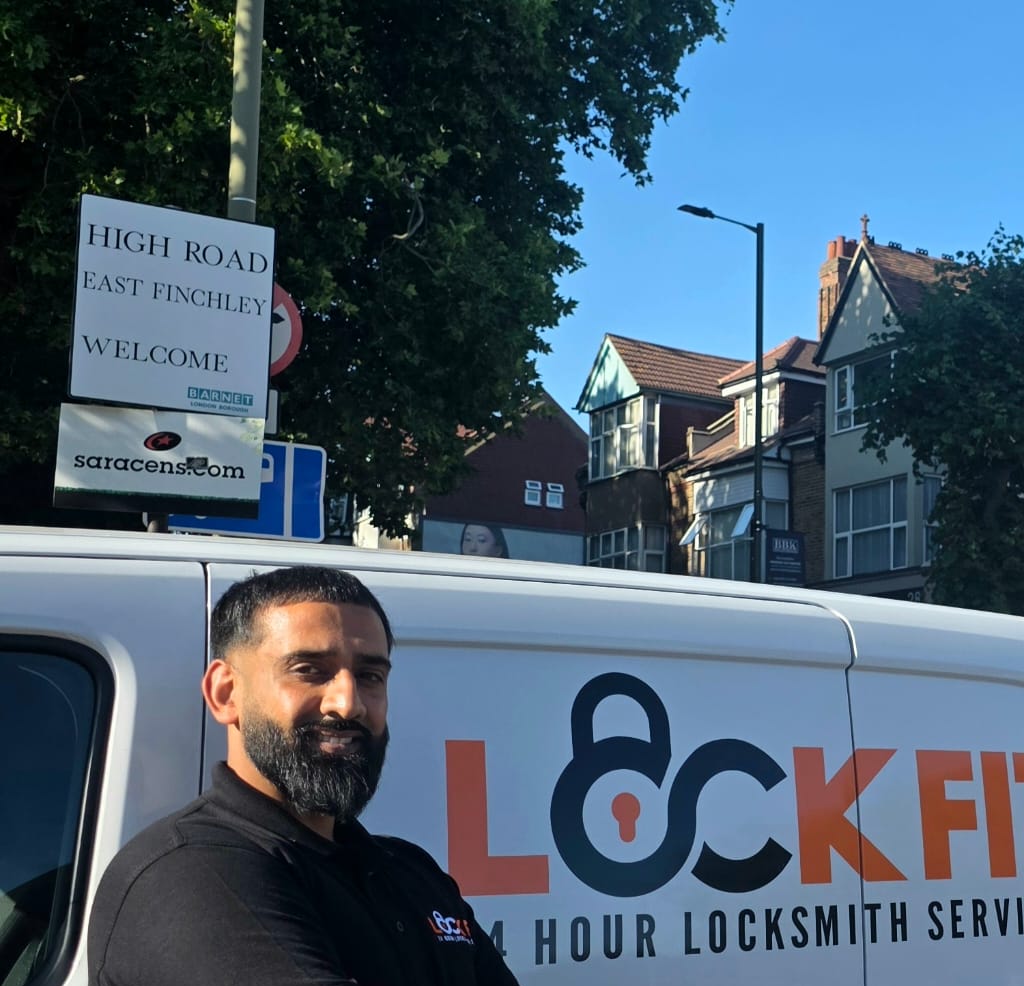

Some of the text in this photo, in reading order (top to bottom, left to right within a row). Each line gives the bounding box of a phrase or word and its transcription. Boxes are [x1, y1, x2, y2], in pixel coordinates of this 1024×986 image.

[88, 224, 268, 274] HIGH ROAD
[83, 271, 266, 316] EAST FINCHLEY
[82, 334, 229, 373] WELCOME
[188, 387, 253, 406] BARNET
[190, 401, 249, 414] LONDON BOROUGH
[535, 912, 657, 965] HOUR
[684, 901, 909, 955] LOCKSMITH
